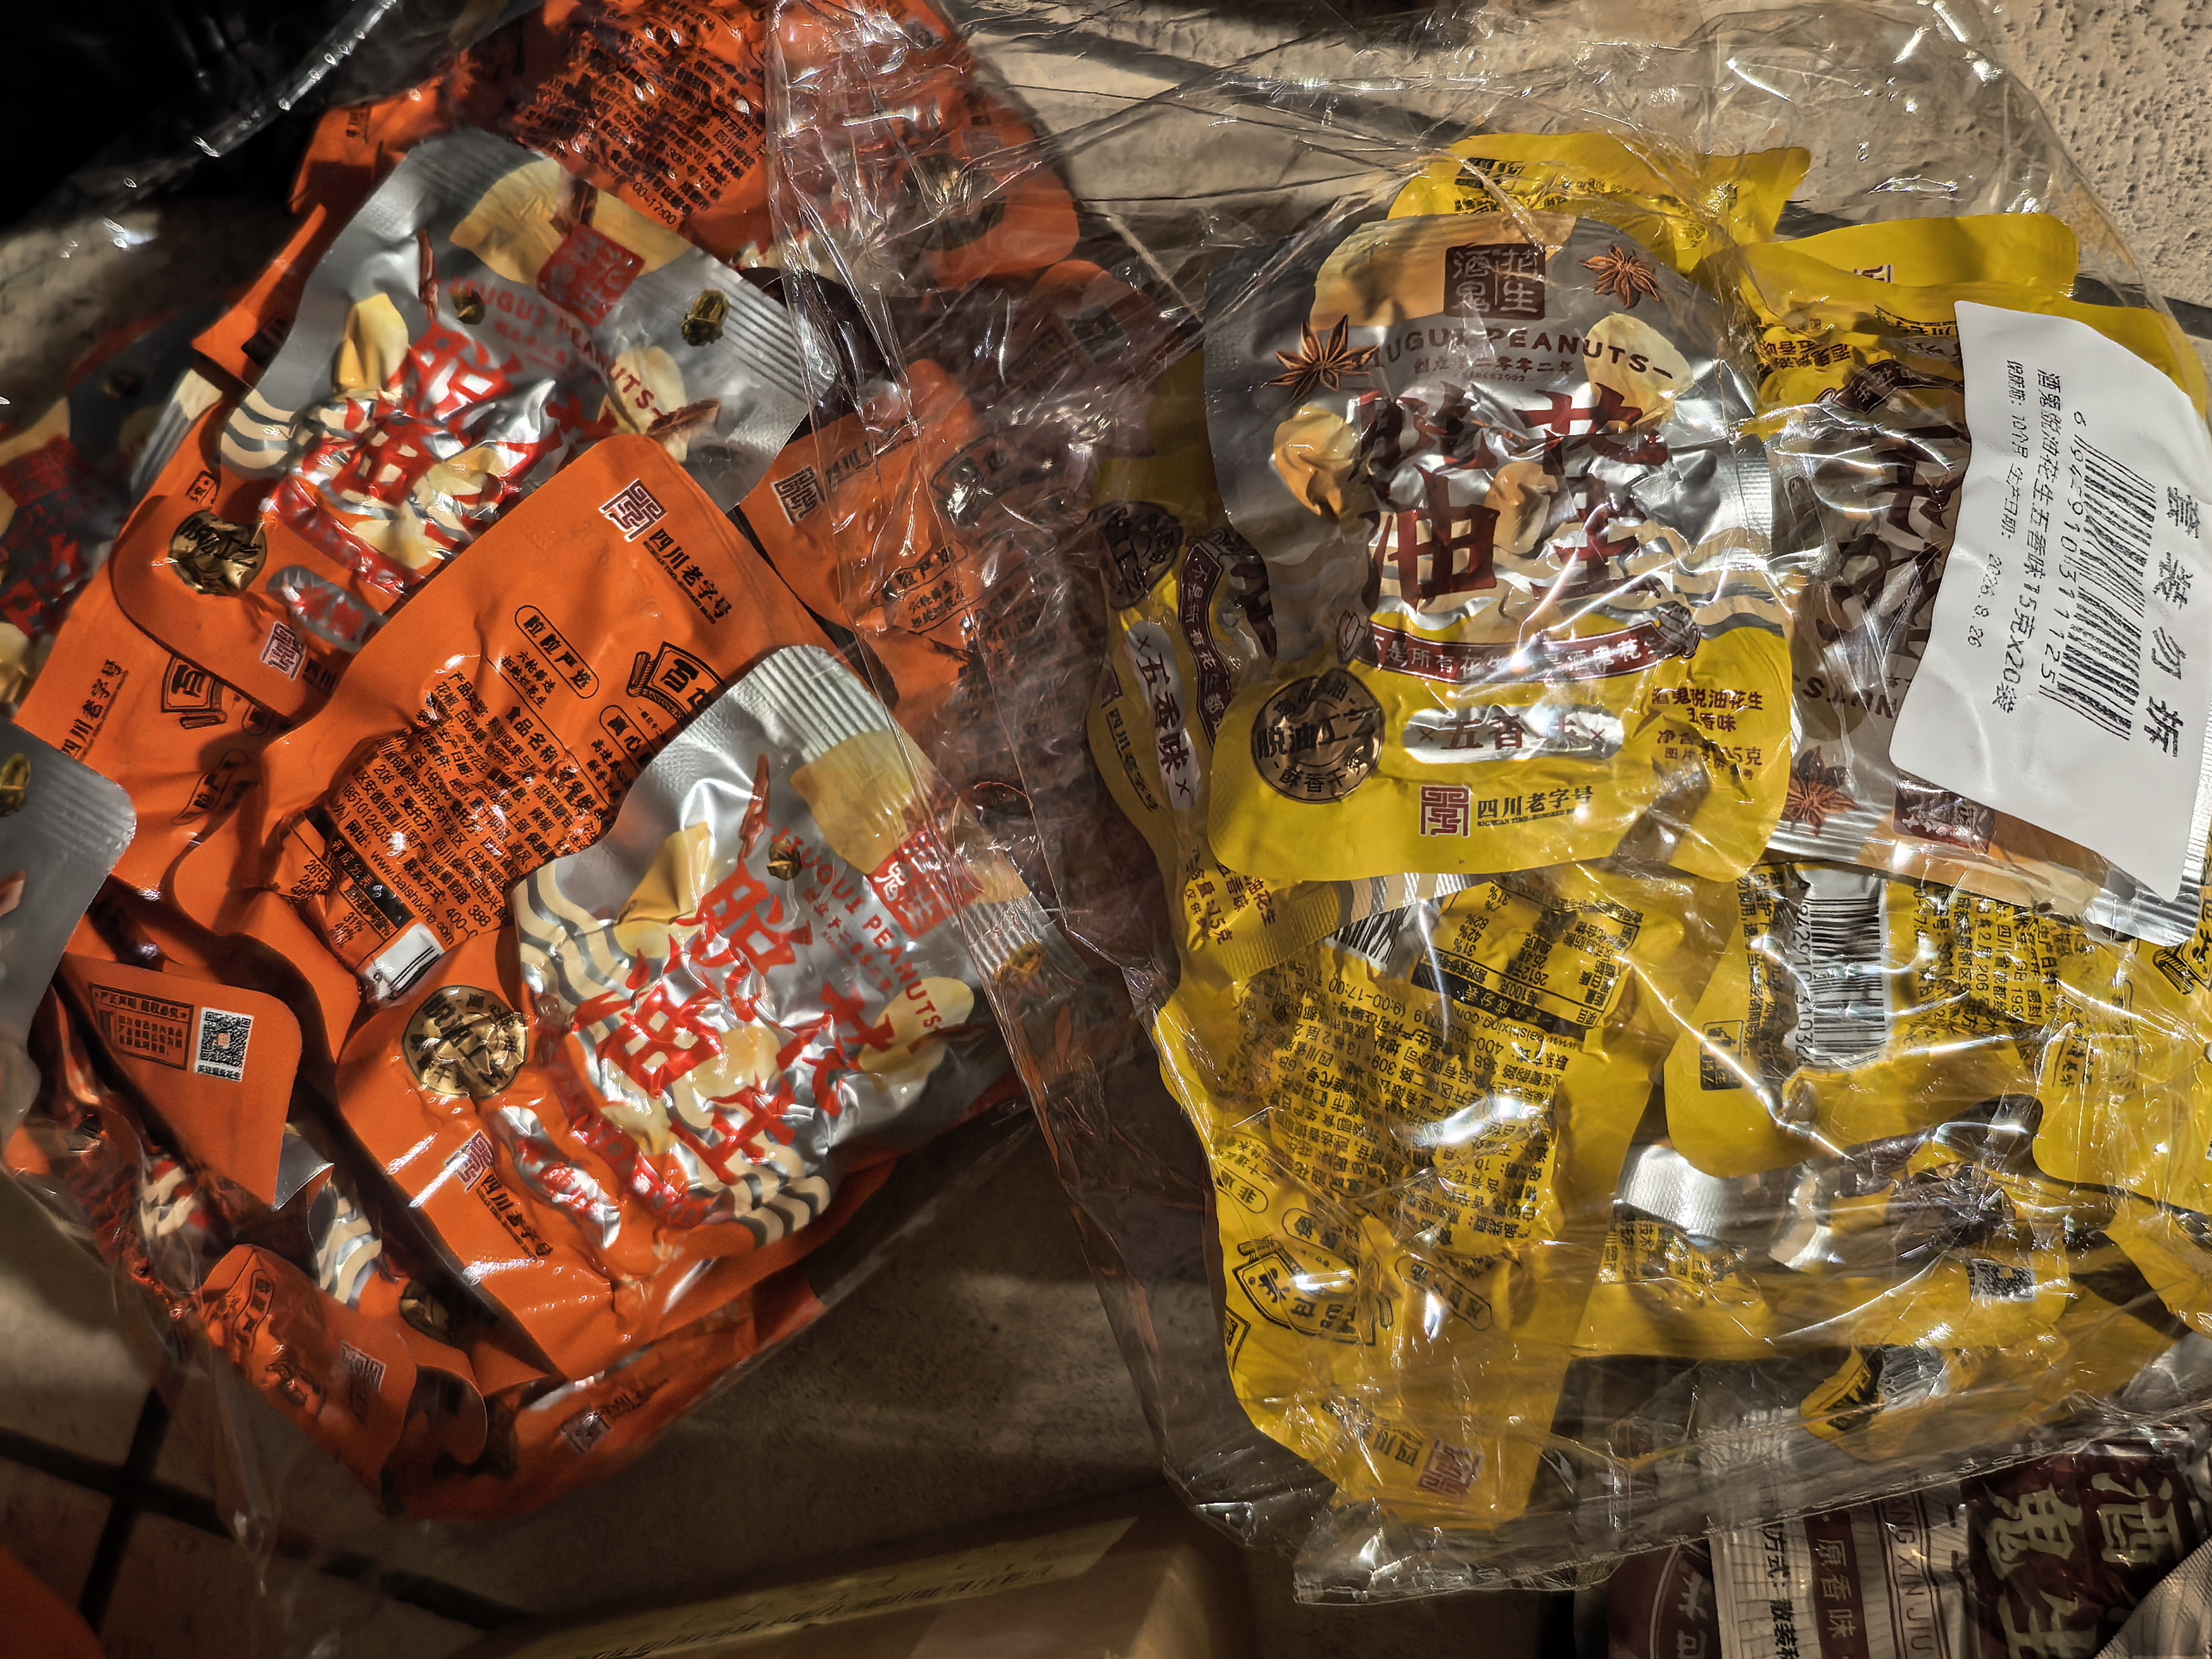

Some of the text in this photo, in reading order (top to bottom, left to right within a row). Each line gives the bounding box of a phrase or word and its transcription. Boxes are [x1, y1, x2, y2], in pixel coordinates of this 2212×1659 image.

[1488, 326, 1649, 375] PEANUTS
[646, 522, 734, 625] 四川老字号
[520, 609, 595, 696] 粒粒严选
[2142, 484, 2200, 758] 套装勿拆
[514, 645, 559, 698] 六轮筛选
[55, 656, 128, 759] 四川老字号
[502, 701, 561, 770] 食品名称
[1135, 651, 1190, 777] 五香味
[1476, 785, 1594, 819] 四川老字号
[400, 853, 450, 911] 联系方式:
[1486, 885, 1512, 906] 31%
[341, 909, 366, 935] 31%
[466, 901, 493, 930] 388
[1450, 936, 1477, 957] 31%
[1456, 922, 1483, 943] 42%
[1463, 911, 1489, 930] 82%
[568, 865, 814, 1096] 脱油
[866, 911, 942, 1030] PEANUTS
[667, 979, 899, 1185] 花生
[1812, 1534, 1858, 1642] 原香味
